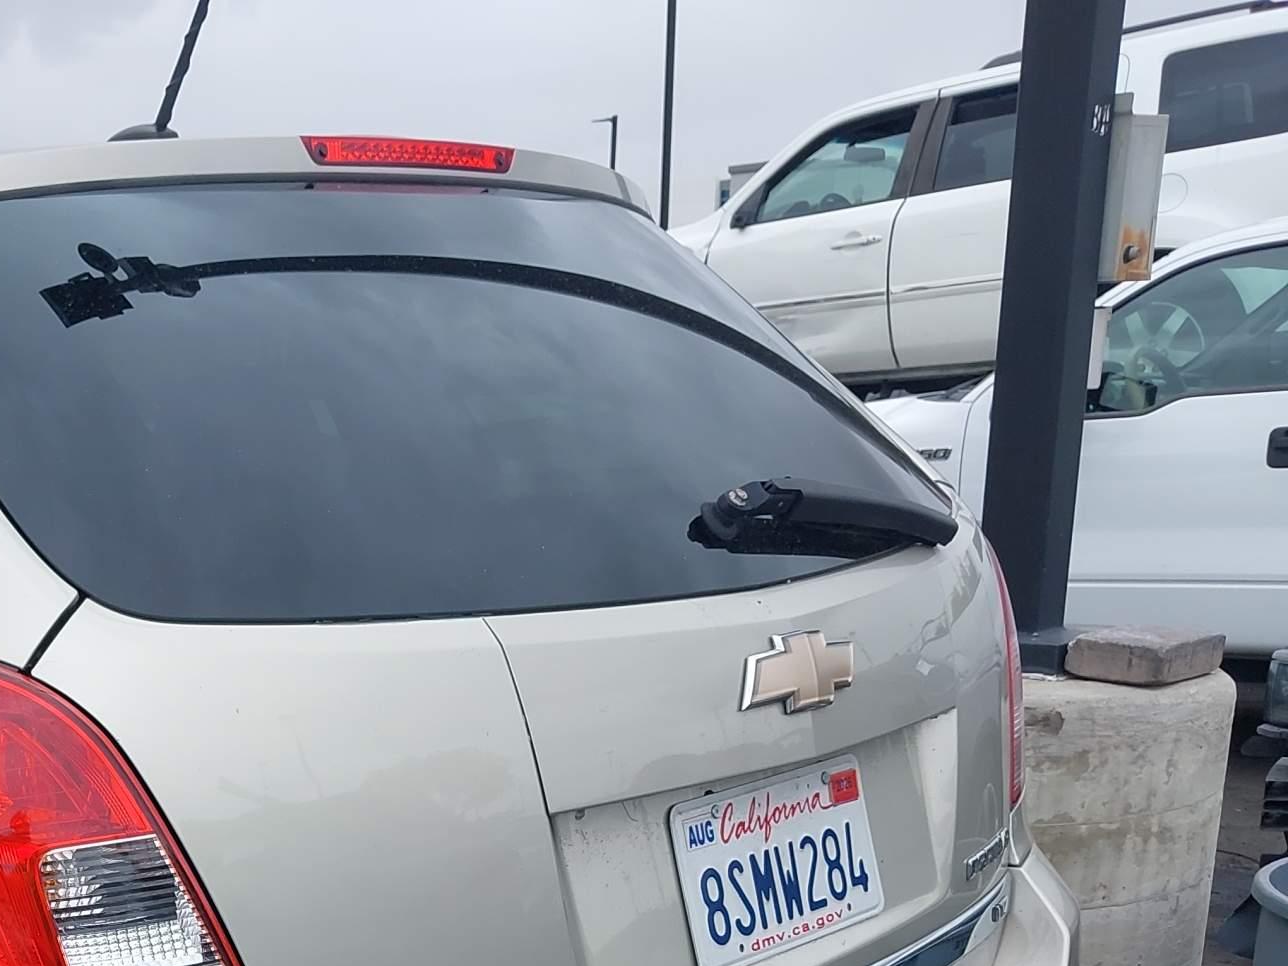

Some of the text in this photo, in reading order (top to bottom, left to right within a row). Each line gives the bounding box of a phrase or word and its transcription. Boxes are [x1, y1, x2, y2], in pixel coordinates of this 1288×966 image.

[688, 820, 715, 849] AUG
[719, 791, 835, 844] California
[700, 821, 869, 946] 8SMW284
[750, 908, 844, 953] dmv.ca.gov
